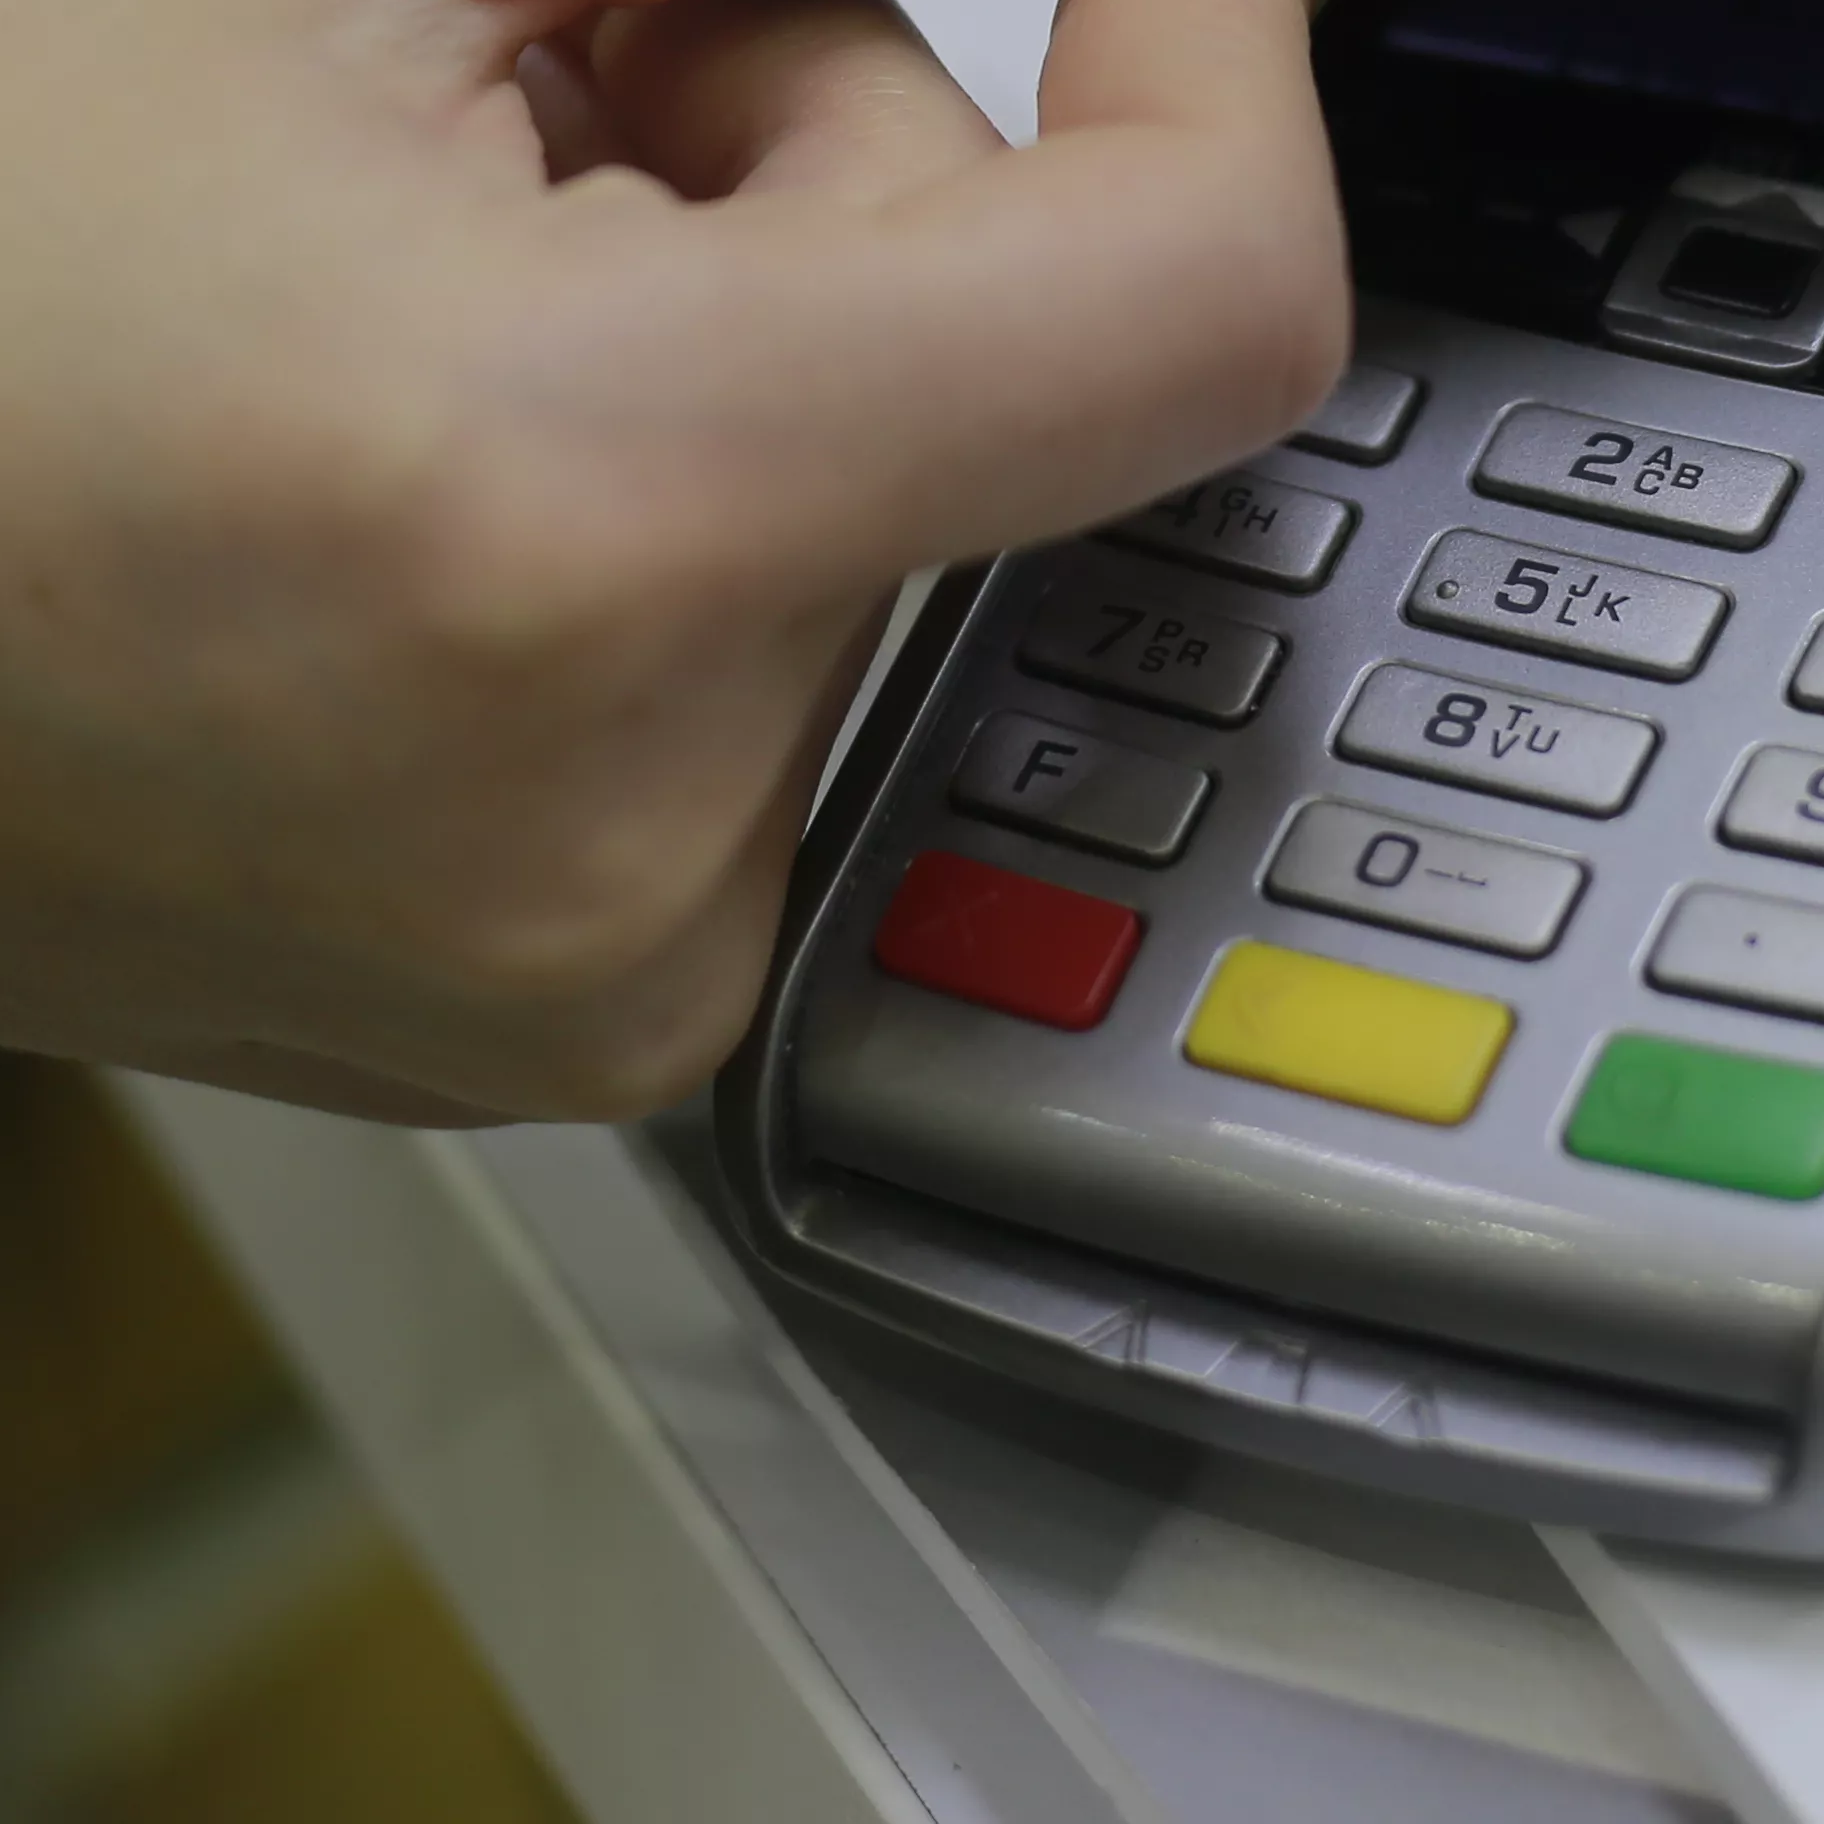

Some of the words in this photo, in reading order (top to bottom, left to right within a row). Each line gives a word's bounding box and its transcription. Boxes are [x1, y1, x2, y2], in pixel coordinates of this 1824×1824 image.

[1568, 430, 1635, 487] 2
[1493, 557, 1562, 615] 5
[1085, 604, 1147, 658] 7
[1422, 691, 1488, 749] 8
[1012, 739, 1079, 795] F
